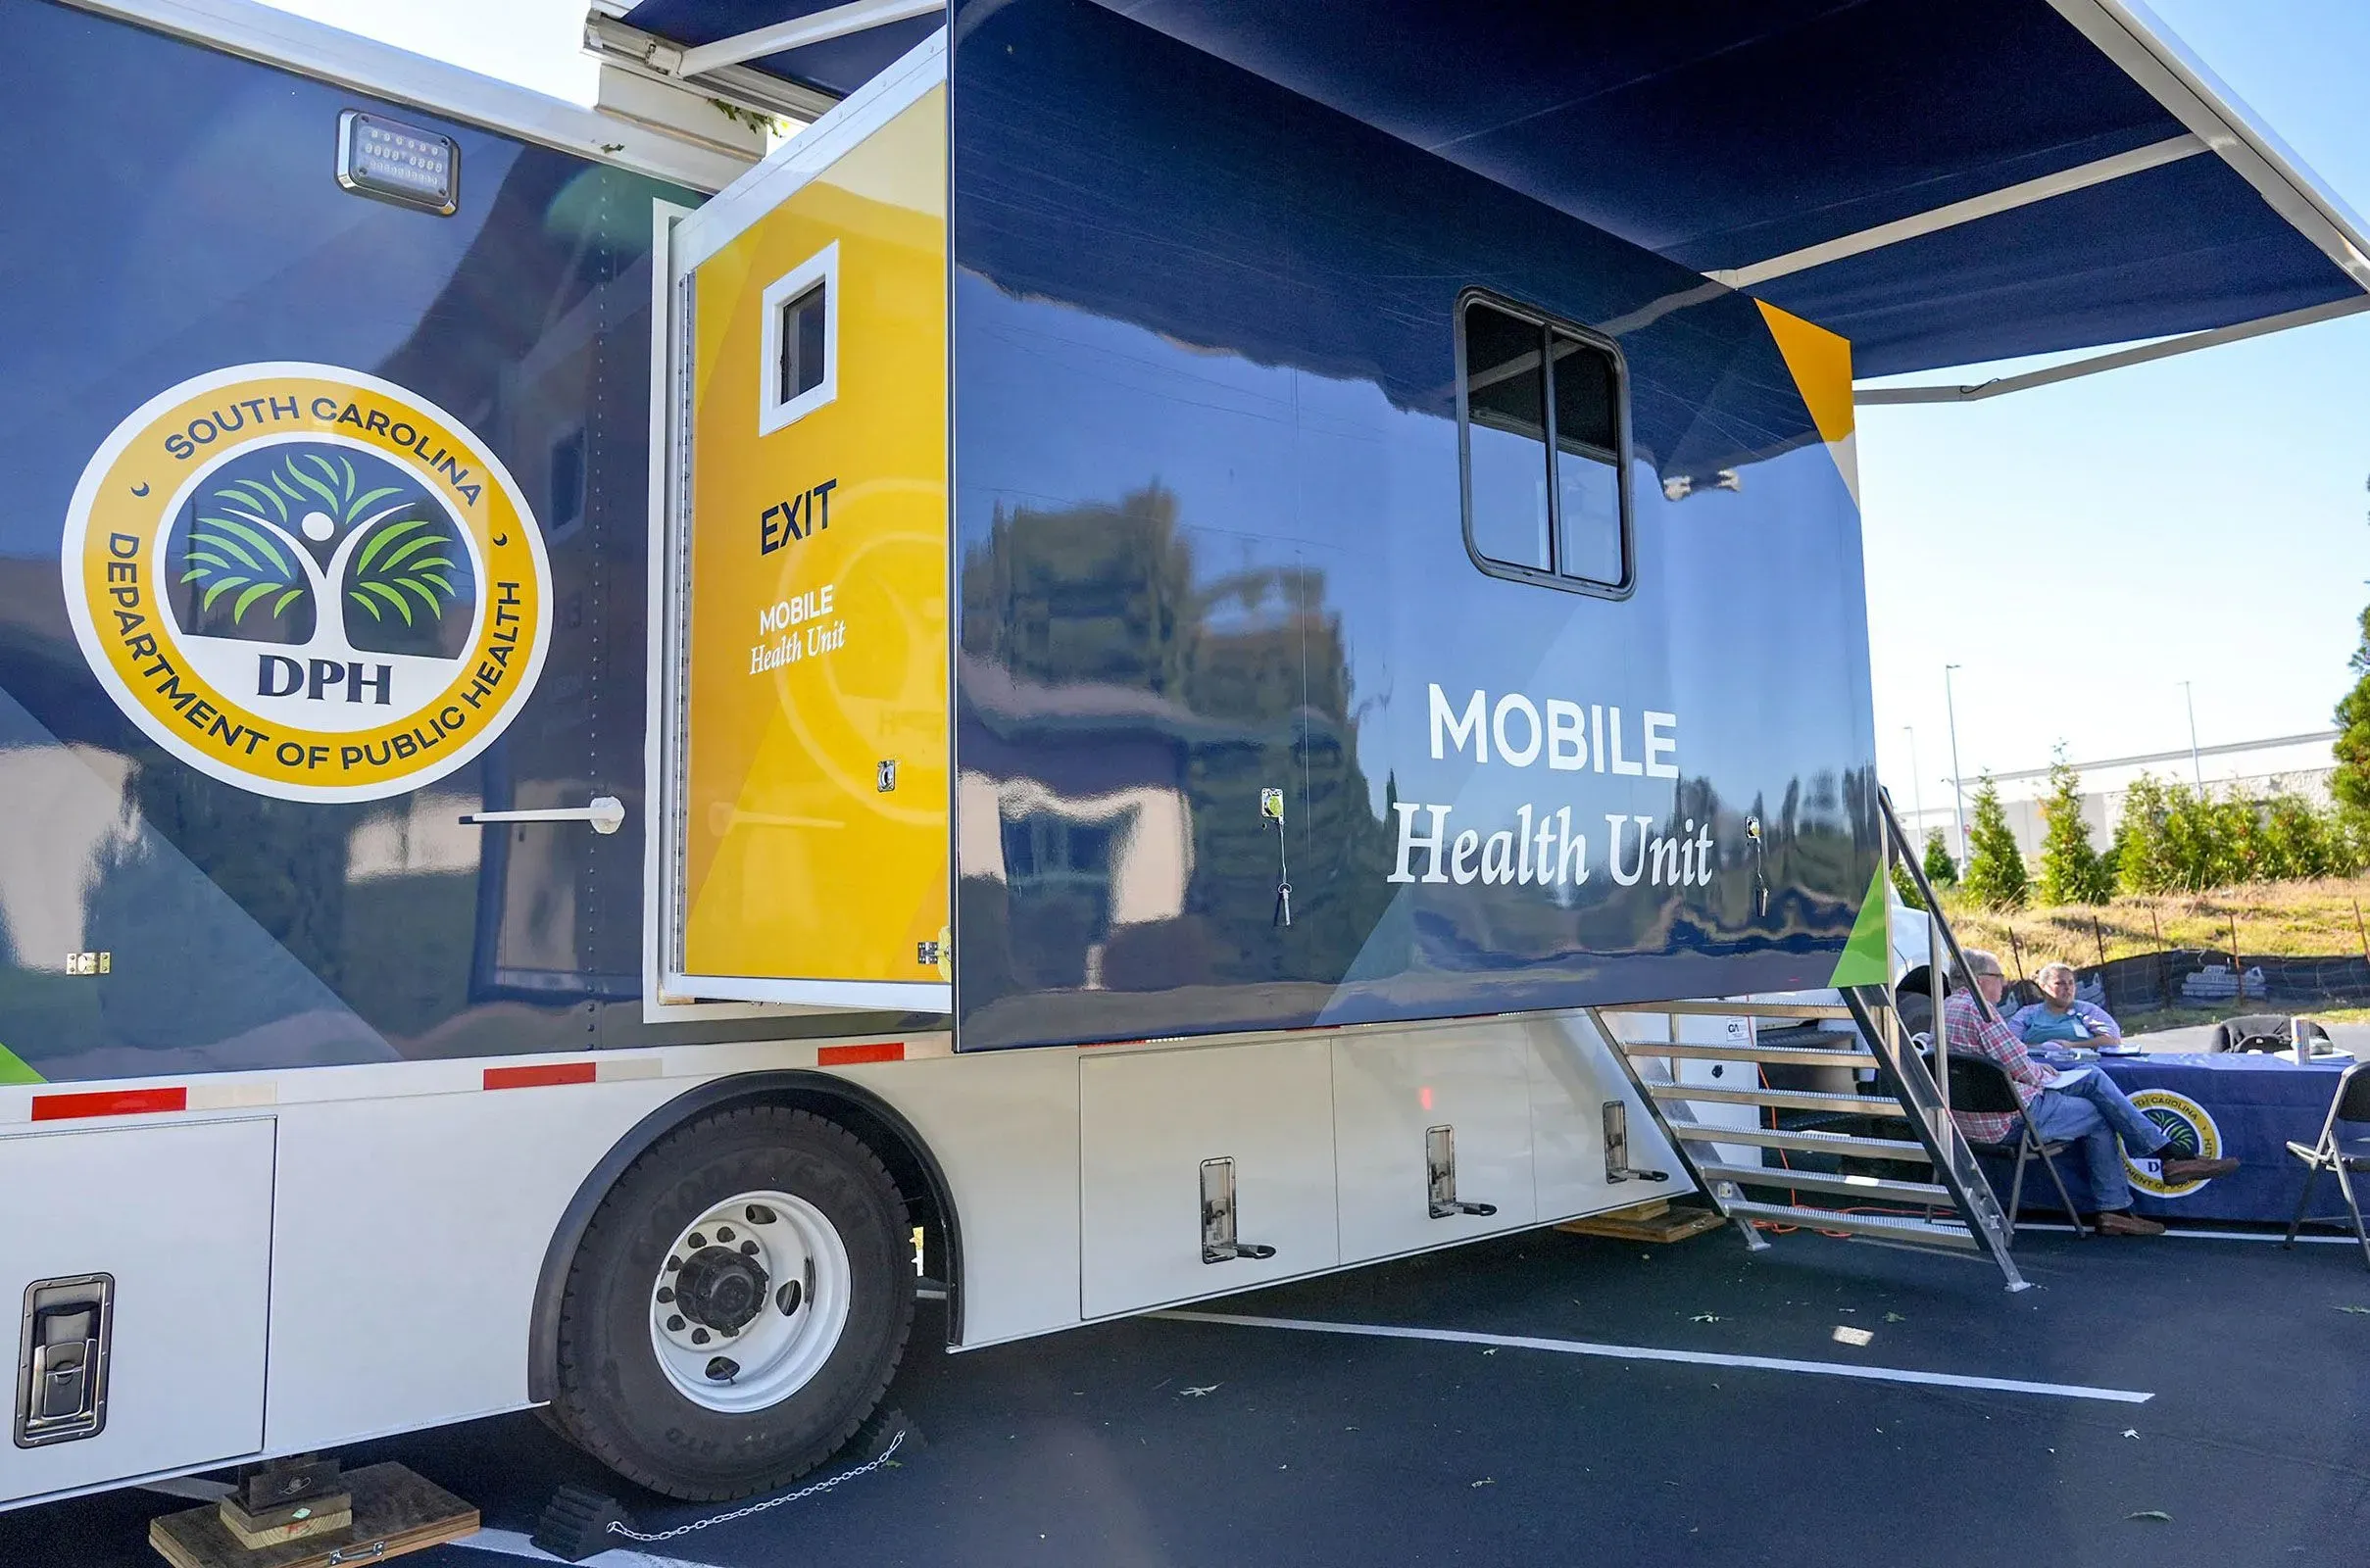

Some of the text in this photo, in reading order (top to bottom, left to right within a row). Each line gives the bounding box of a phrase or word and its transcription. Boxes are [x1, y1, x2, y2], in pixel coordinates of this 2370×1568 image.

[165, 395, 482, 508] SOUTH CAROLINA
[761, 477, 837, 556] EXIT
[749, 619, 846, 675] Health Unit
[760, 583, 834, 635] MOBILE
[108, 531, 520, 770] DEPARTMENT OF PUBLIC HEALTH
[256, 654, 392, 706] DPH
[1428, 682, 1680, 779] MOBILE
[1386, 802, 1714, 888] Health Unit
[2150, 1097, 2197, 1120] CAROLINA
